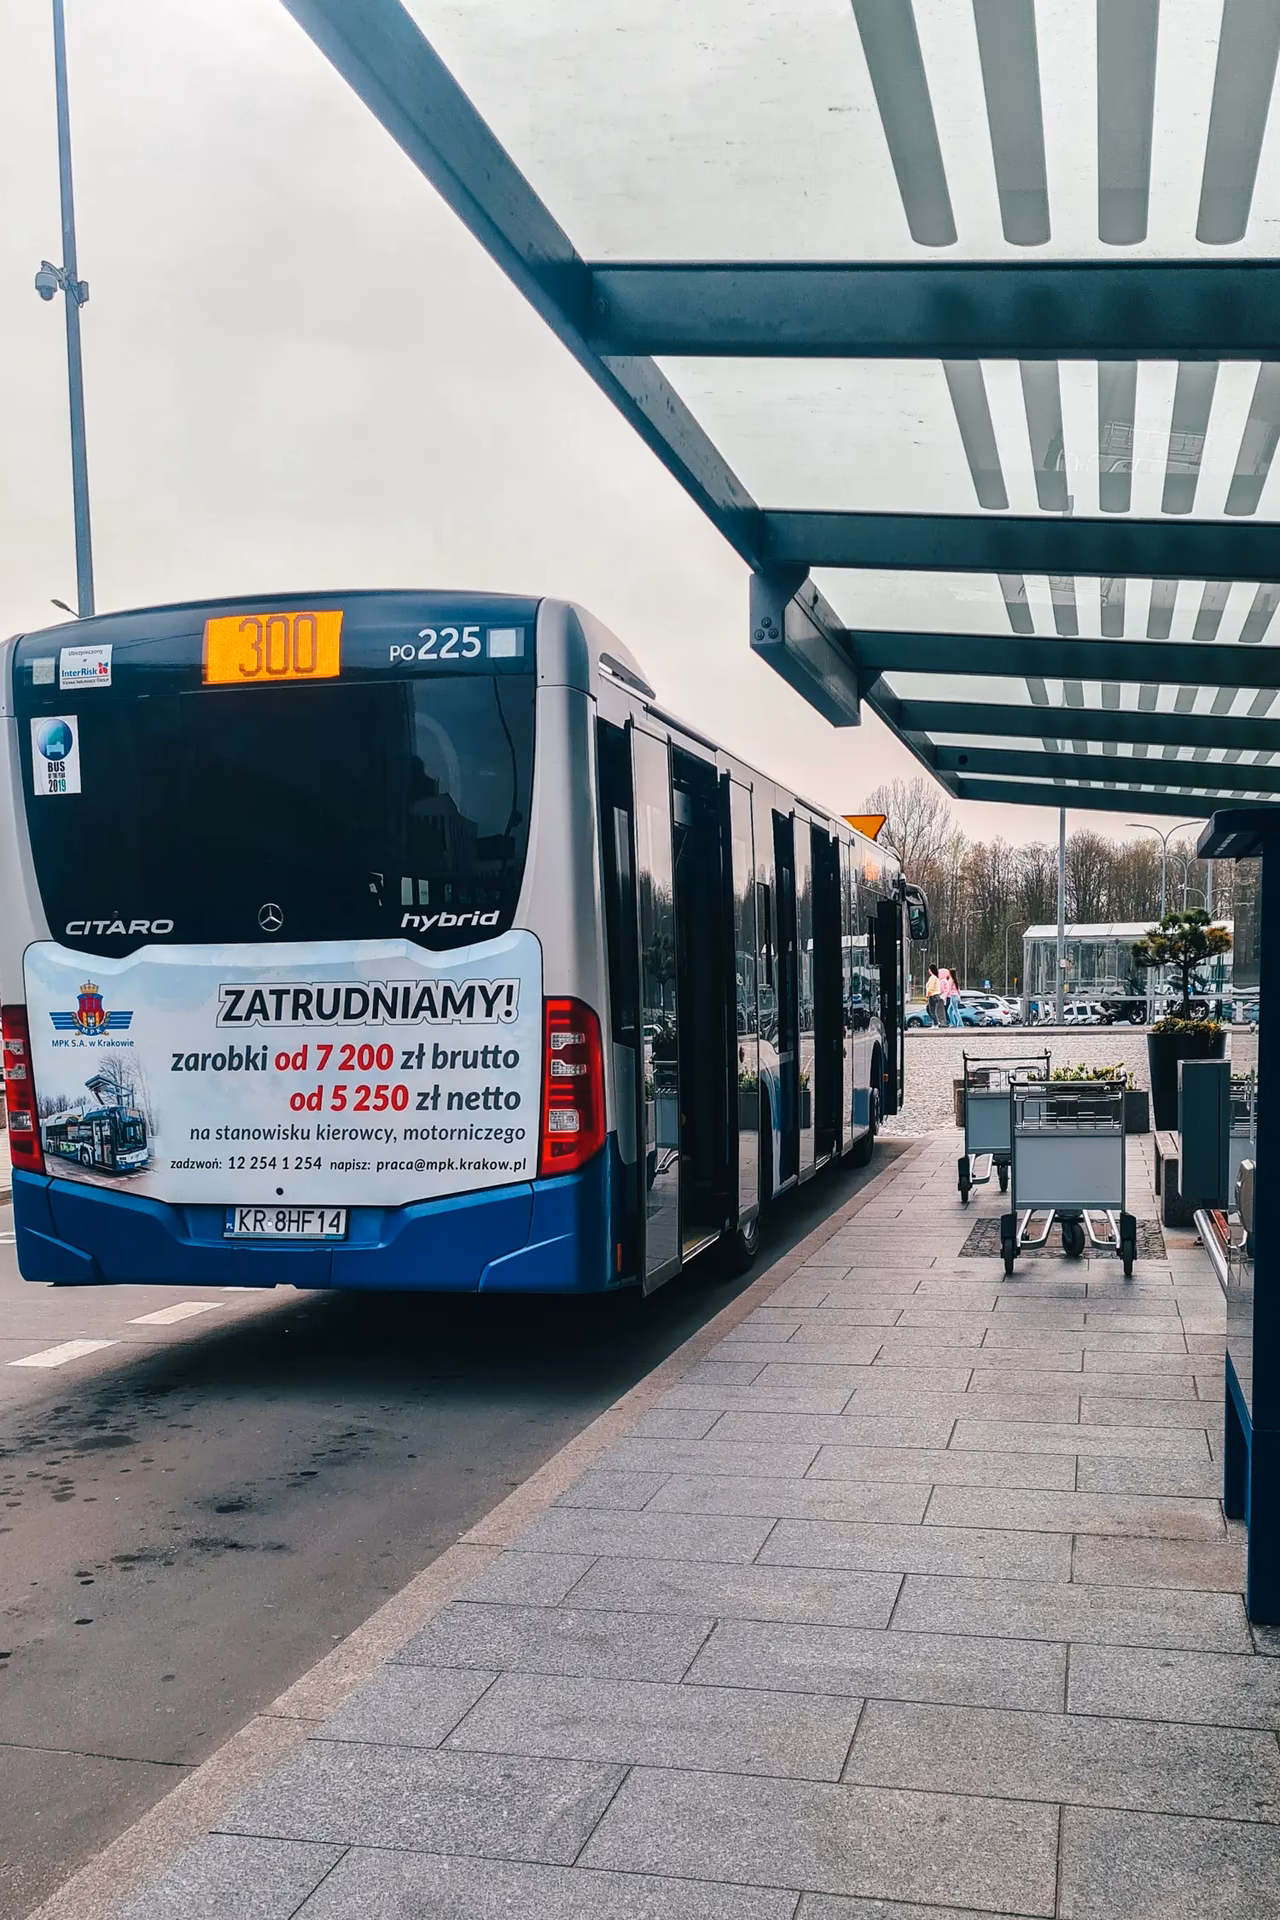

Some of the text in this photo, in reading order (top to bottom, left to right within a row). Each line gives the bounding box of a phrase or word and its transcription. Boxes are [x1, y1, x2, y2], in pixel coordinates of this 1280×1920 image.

[239, 614, 317, 677] 300
[61, 667, 97, 677] InterRisk
[48, 761, 65, 772] BUS
[49, 779, 66, 792] 2019
[65, 919, 174, 935] CITARO
[401, 910, 500, 932] hybrid
[222, 984, 515, 1021] ZATRUDNIAMY!
[51, 1039, 70, 1047] MPK
[71, 1039, 88, 1047] S.A.
[97, 1039, 134, 1047] Krakowie
[171, 1045, 269, 1073] zarobki
[274, 1044, 308, 1071] od
[400, 1043, 426, 1070] zł
[431, 1043, 520, 1070] brutto
[290, 1085, 323, 1111] od
[415, 1084, 441, 1111] zł
[447, 1086, 521, 1111] netto
[190, 1123, 526, 1144] na stanowisku kierowcy, motorniczego
[170, 1156, 527, 1172] zadzwoń: 12 254 1 254 napisz: praca@mpk.krakow.pl
[238, 1209, 341, 1233] KR 8HF14
